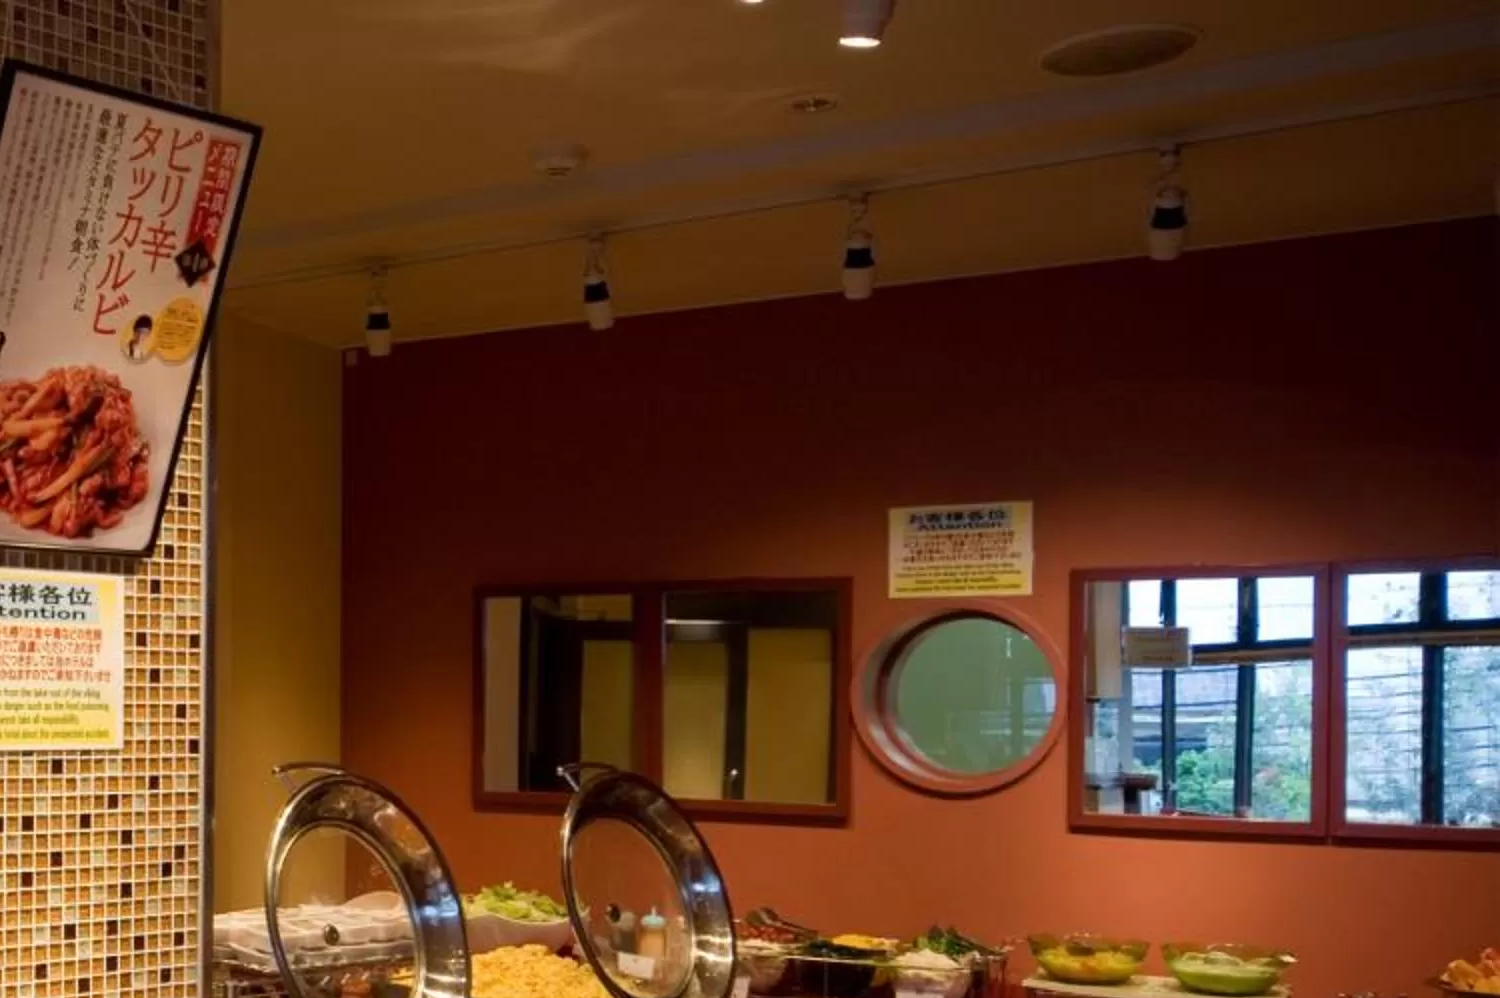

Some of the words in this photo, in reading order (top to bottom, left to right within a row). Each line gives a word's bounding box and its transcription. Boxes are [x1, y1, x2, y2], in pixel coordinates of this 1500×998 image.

[92, 116, 163, 335] タッカルビ
[140, 126, 204, 273] ピリ辛
